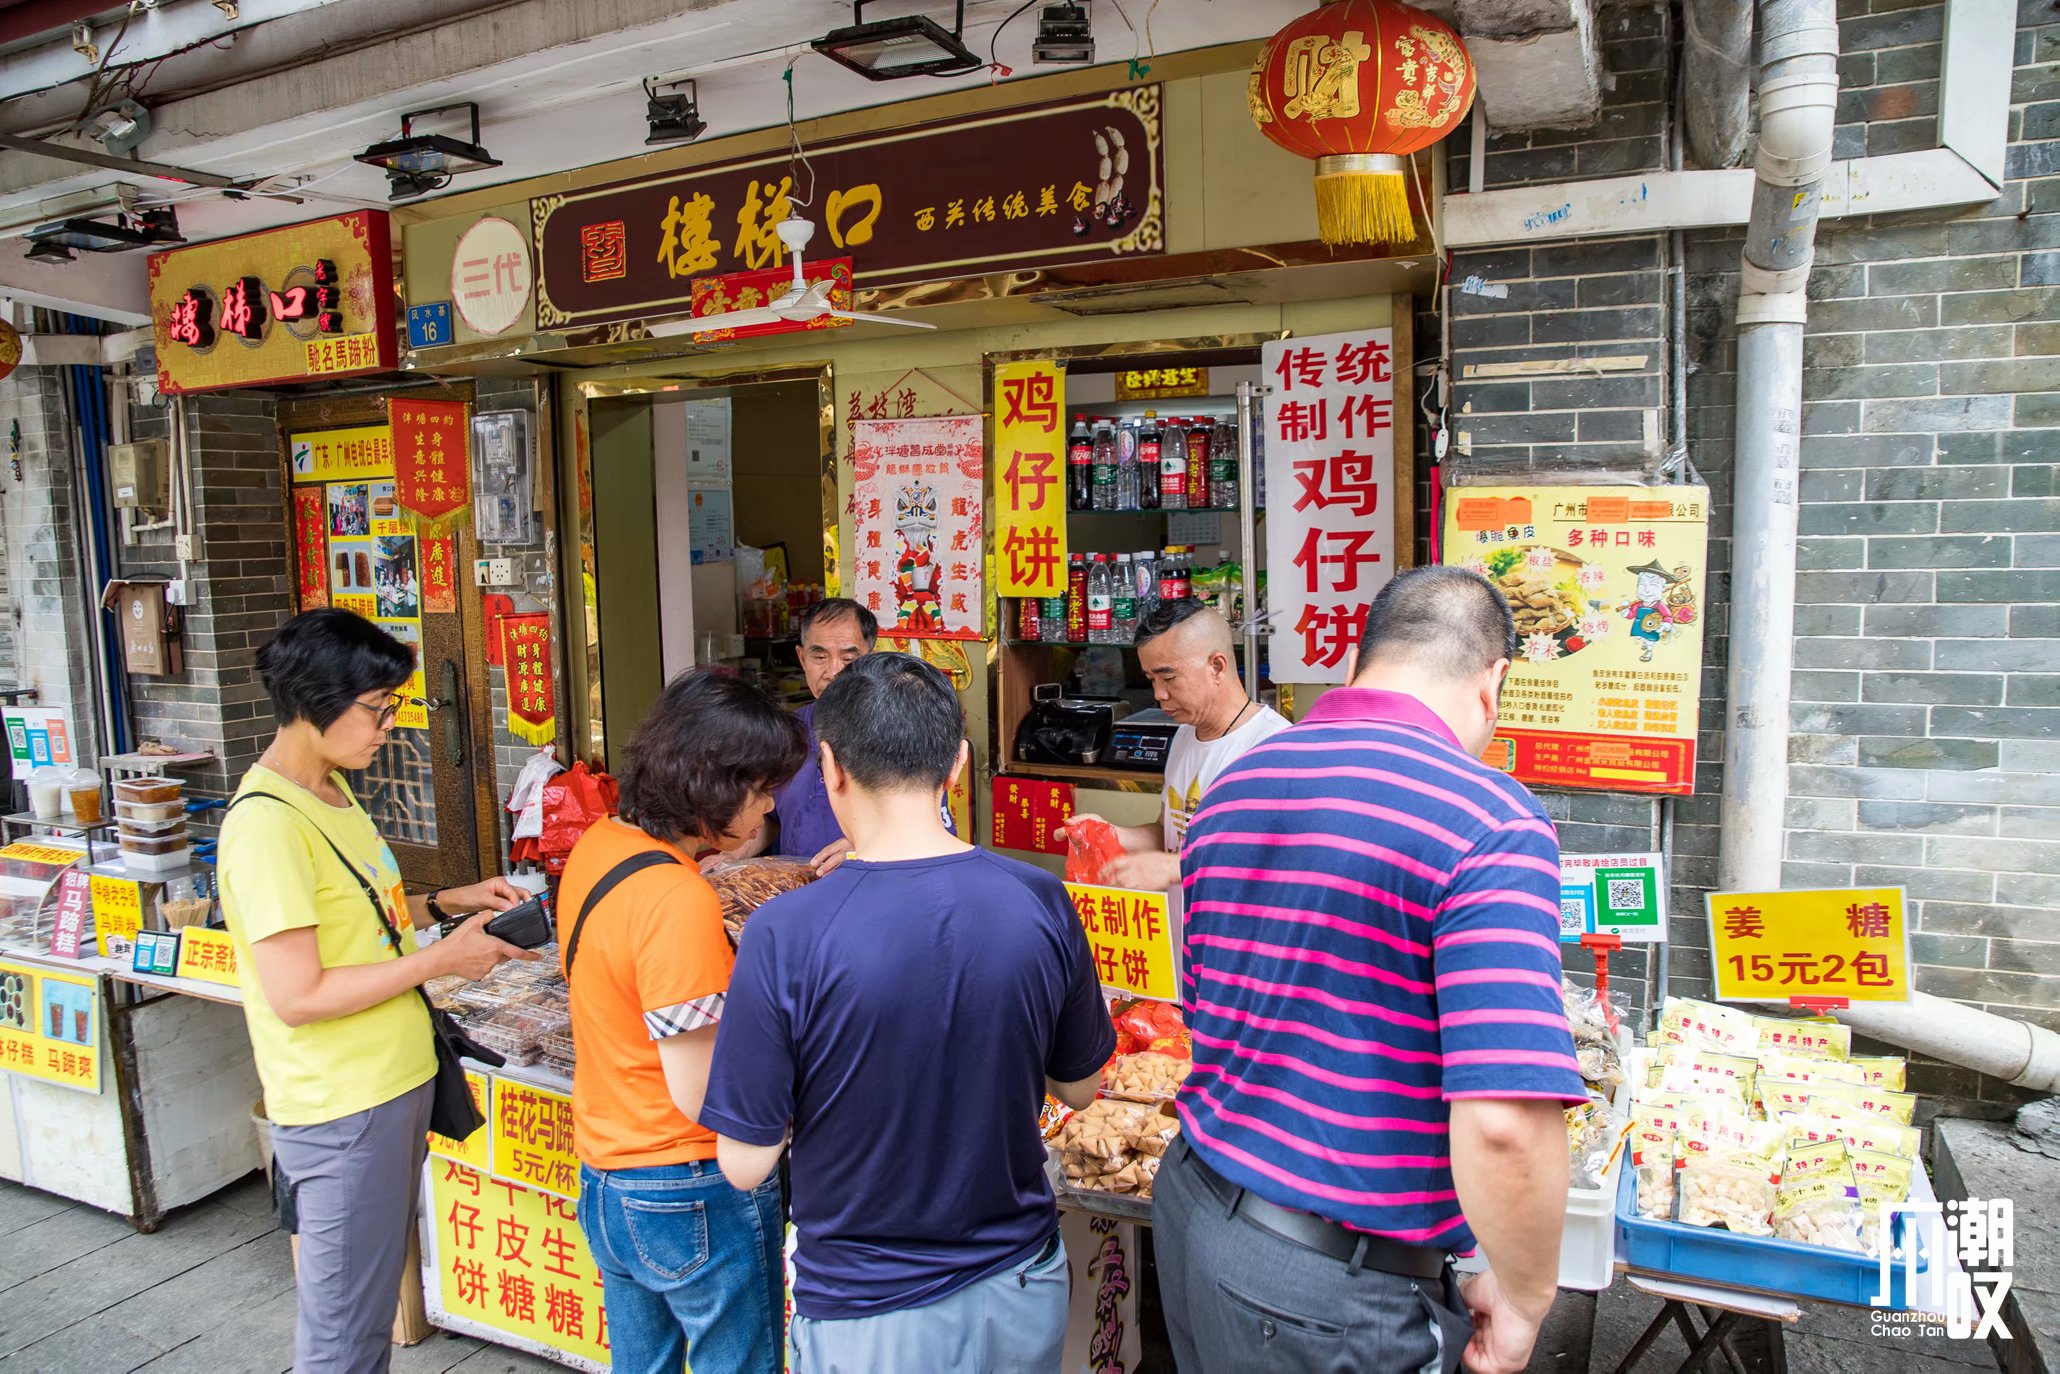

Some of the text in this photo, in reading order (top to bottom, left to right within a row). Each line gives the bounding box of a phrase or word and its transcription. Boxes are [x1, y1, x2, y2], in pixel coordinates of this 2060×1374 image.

[1422, 64, 1440, 106] 吉祥
[657, 176, 882, 279] 樓梯口
[914, 181, 1093, 231] 西关传统美食
[463, 252, 523, 300] 三代
[170, 278, 307, 346] 樓梯口
[411, 306, 446, 320] 风水基
[422, 321, 438, 342] 16
[307, 336, 376, 372] 馳名馬蹄粉
[1275, 340, 1391, 391] 传统
[1277, 394, 1393, 443] 制作
[314, 438, 393, 469] 广东、广州电视台最早
[1188, 448, 1200, 495] 王老吉
[1002, 370, 1061, 588] 鸡仔饼
[1553, 503, 1587, 517] 广州市
[951, 497, 968, 613] 龍虎生威
[1292, 449, 1381, 670] 鸡仔饼
[1529, 554, 1552, 567] 椒盐
[1567, 529, 1657, 548] 多种口味
[1579, 569, 1605, 582] 香辣
[1070, 586, 1081, 630] 王老吉
[1581, 620, 1609, 634] 烧烤
[65, 871, 90, 888] 招牌
[1560, 858, 1647, 868] 完毕敬请给店员过目
[56, 890, 83, 953] 马蹄糕
[1071, 892, 1161, 941] 统制作
[1094, 943, 1150, 990] 仔饼
[1728, 950, 1894, 987] 15元2包
[48, 1048, 92, 1079] 马蹄爽
[500, 1084, 579, 1157] 桂花马蹄
[512, 1149, 576, 1192] 5元/杯
[445, 1159, 489, 1309] 鸡仔饼
